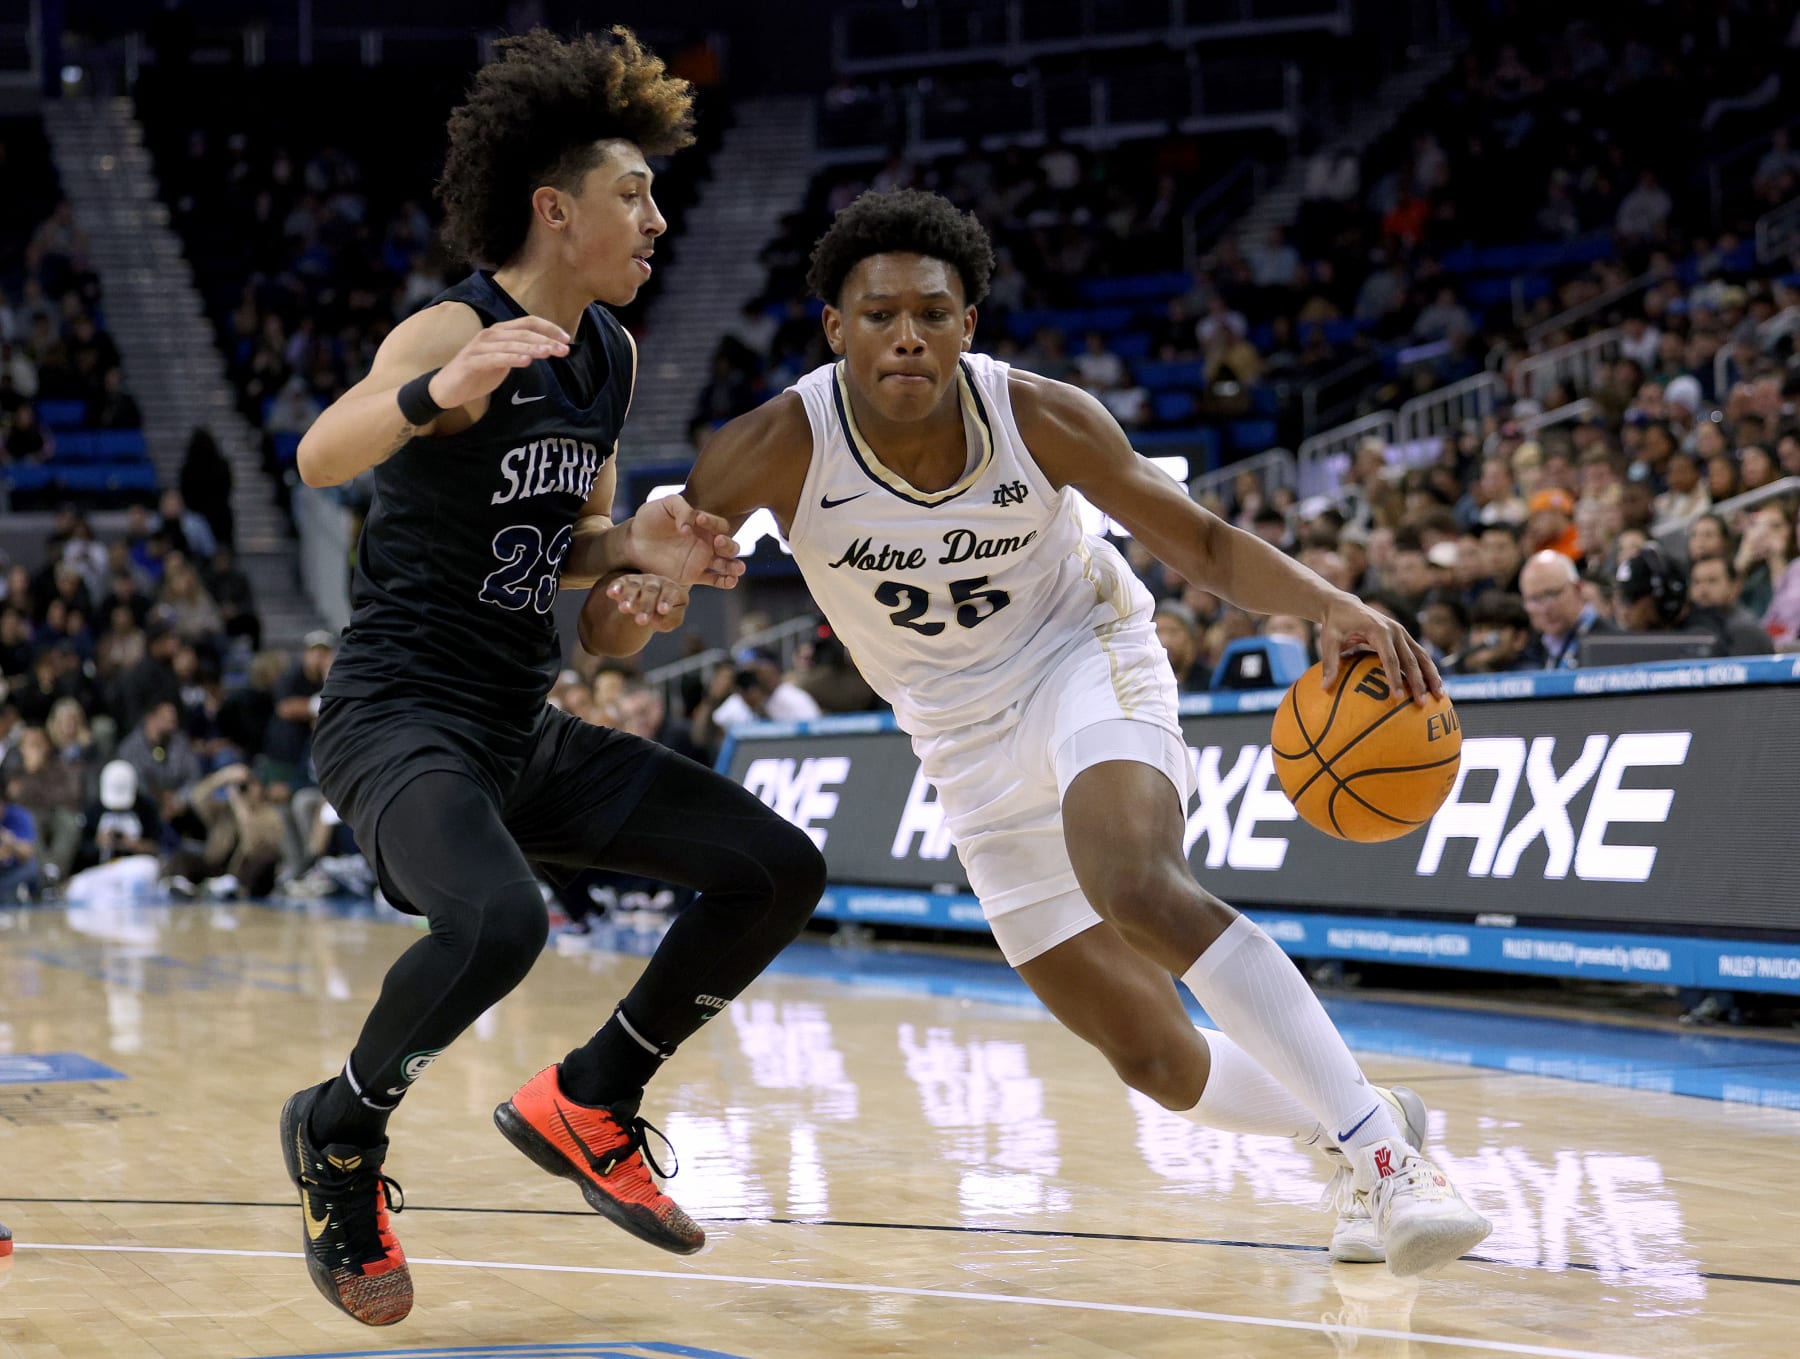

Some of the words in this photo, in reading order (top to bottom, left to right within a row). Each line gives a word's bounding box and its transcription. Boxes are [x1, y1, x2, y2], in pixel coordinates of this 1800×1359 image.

[490, 437, 607, 505] SIERR
[828, 537, 926, 571] Notre
[938, 528, 1037, 565] Dame
[874, 574, 1011, 636] 25
[1182, 744, 1298, 871] XE
[1415, 731, 1692, 882] AXE
[1757, 956, 1800, 980] PAVILIO
